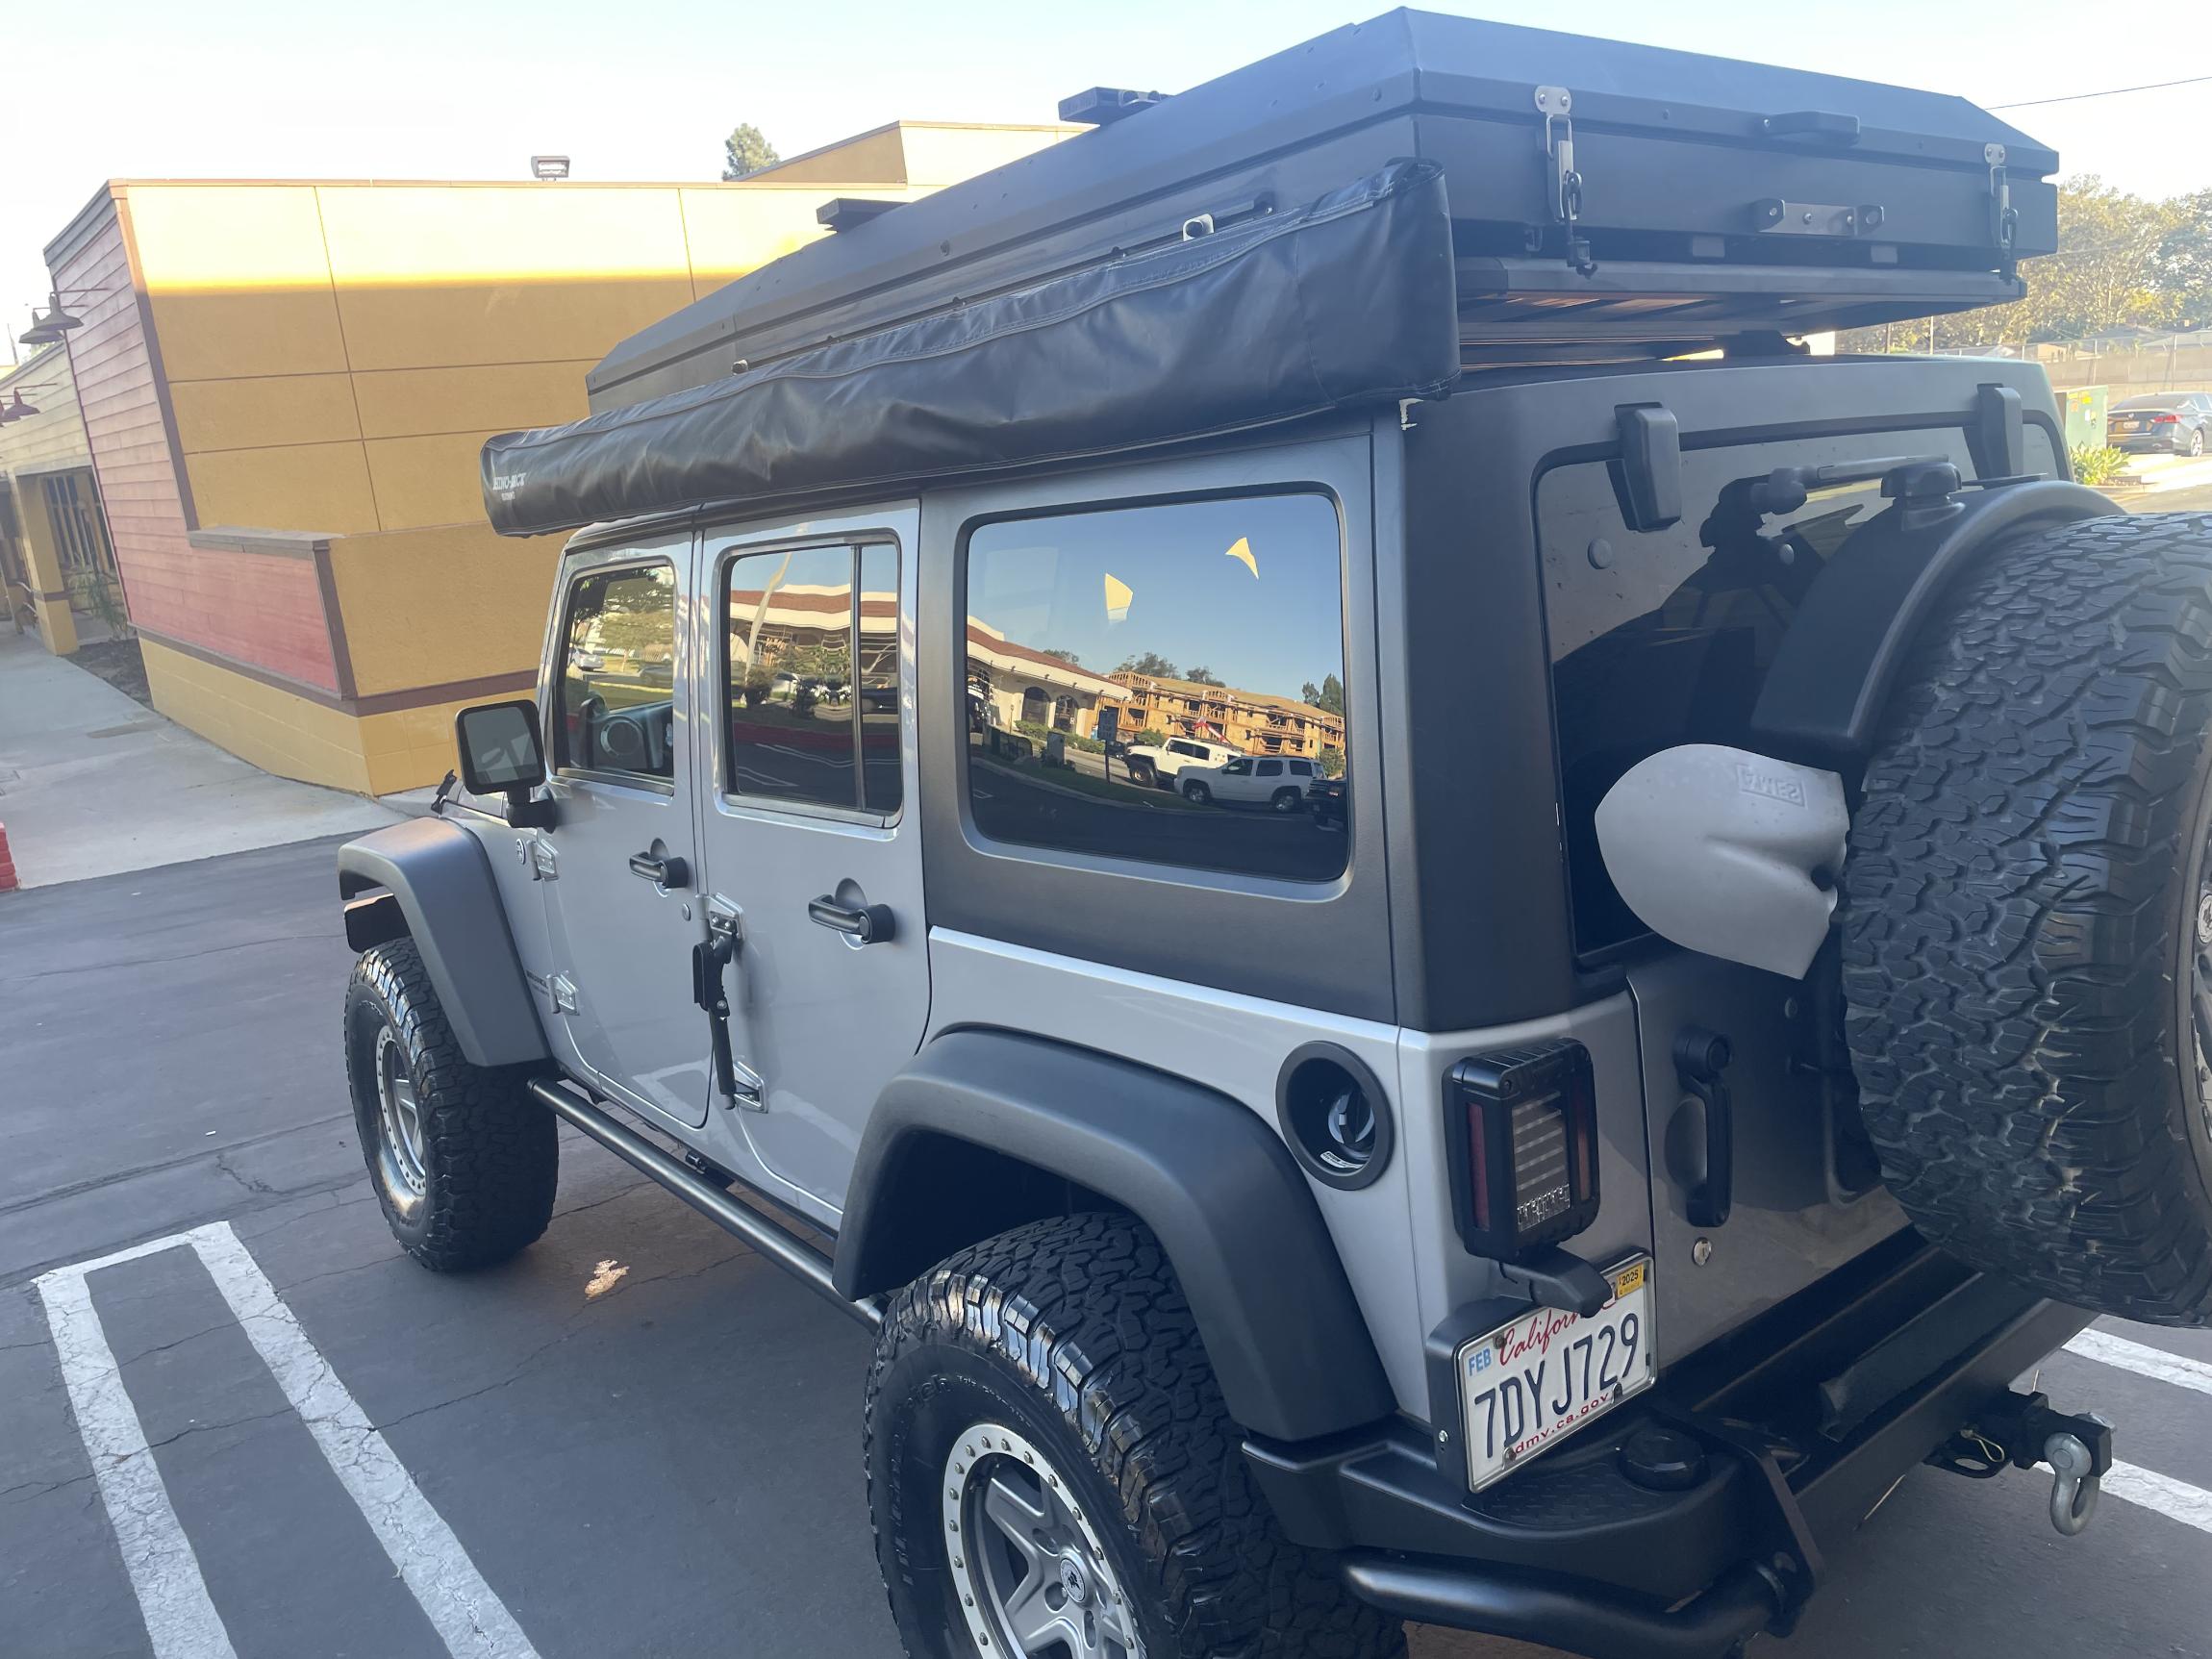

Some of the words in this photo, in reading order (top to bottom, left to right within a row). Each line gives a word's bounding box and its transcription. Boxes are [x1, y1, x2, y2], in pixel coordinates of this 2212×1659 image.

[1621, 1269, 1639, 1286] 2025
[1469, 1347, 1492, 1377] FEB
[1499, 1301, 1616, 1366] Califor
[1473, 1313, 1639, 1459] 7DYJ729
[1516, 1393, 1609, 1454] dmv.ca.gov
